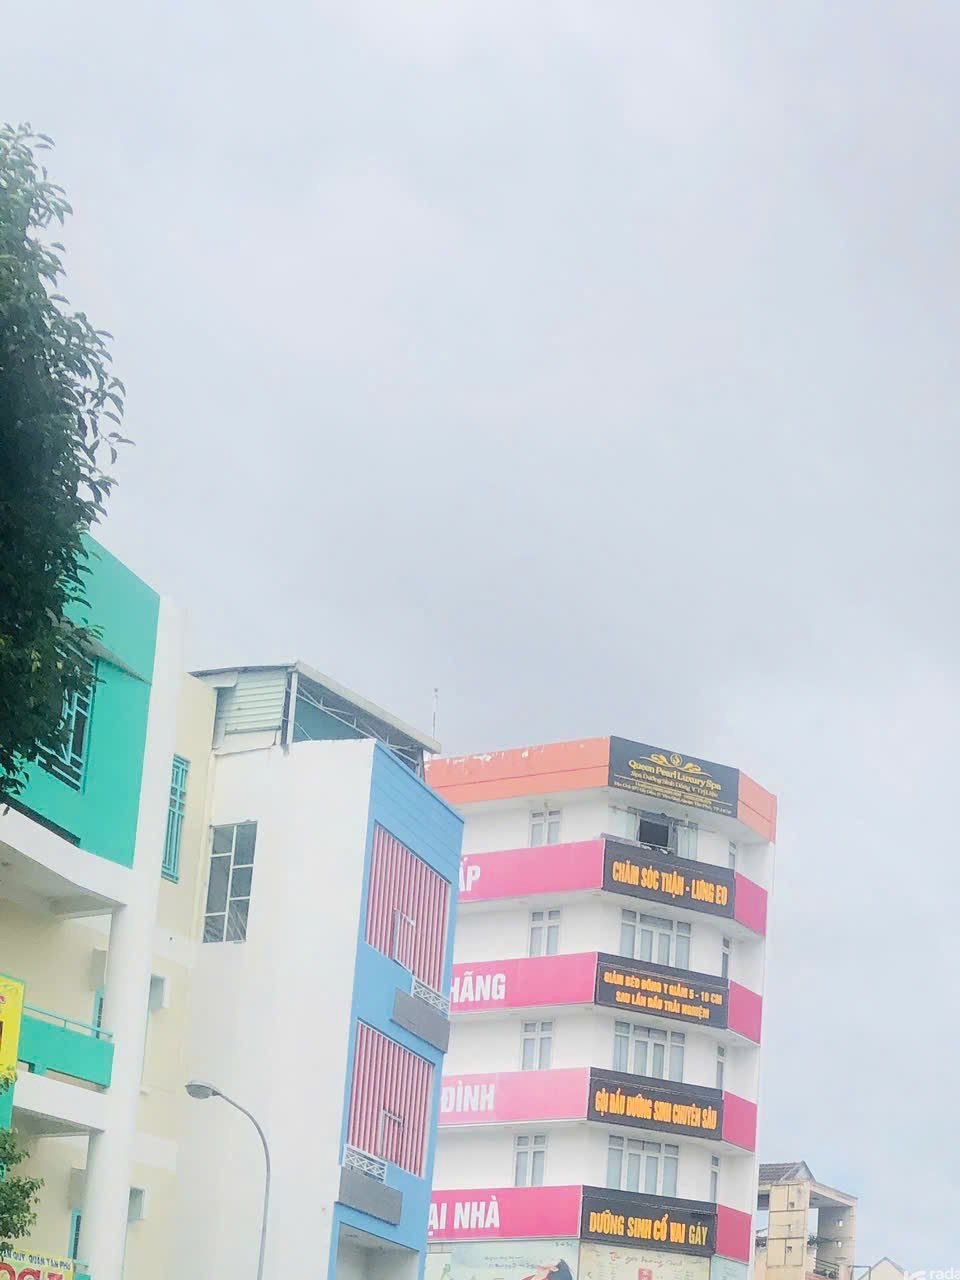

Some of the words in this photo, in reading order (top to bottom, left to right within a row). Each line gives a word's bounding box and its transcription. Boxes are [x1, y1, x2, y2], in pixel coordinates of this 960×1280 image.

[628, 759, 655, 774] Queen
[656, 766, 676, 779] Pearl
[677, 772, 706, 786] Luxury
[706, 779, 722, 791] Spa
[612, 860, 639, 886] CHĂM
[641, 865, 659, 890] SÓC
[661, 871, 684, 898] THẬN
[691, 879, 715, 904] LƯNG
[715, 884, 728, 906] EO
[604, 970, 625, 986] GIẢM
[689, 989, 695, 1000] 5
[701, 991, 710, 1003] 10
[440, 1080, 495, 1113] ĐÌNH
[595, 1087, 609, 1117] GỘI
[654, 1100, 672, 1123] SINH
[673, 1103, 701, 1127] CHUYÊN
[702, 1105, 718, 1130] SÂU
[454, 1195, 500, 1230] NHÀ
[589, 1209, 625, 1236] DƯỠNG
[627, 1217, 652, 1240] SINH
[653, 1213, 669, 1242] CỔ
[670, 1222, 686, 1244] VAI
[688, 1221, 708, 1246] GÁY
